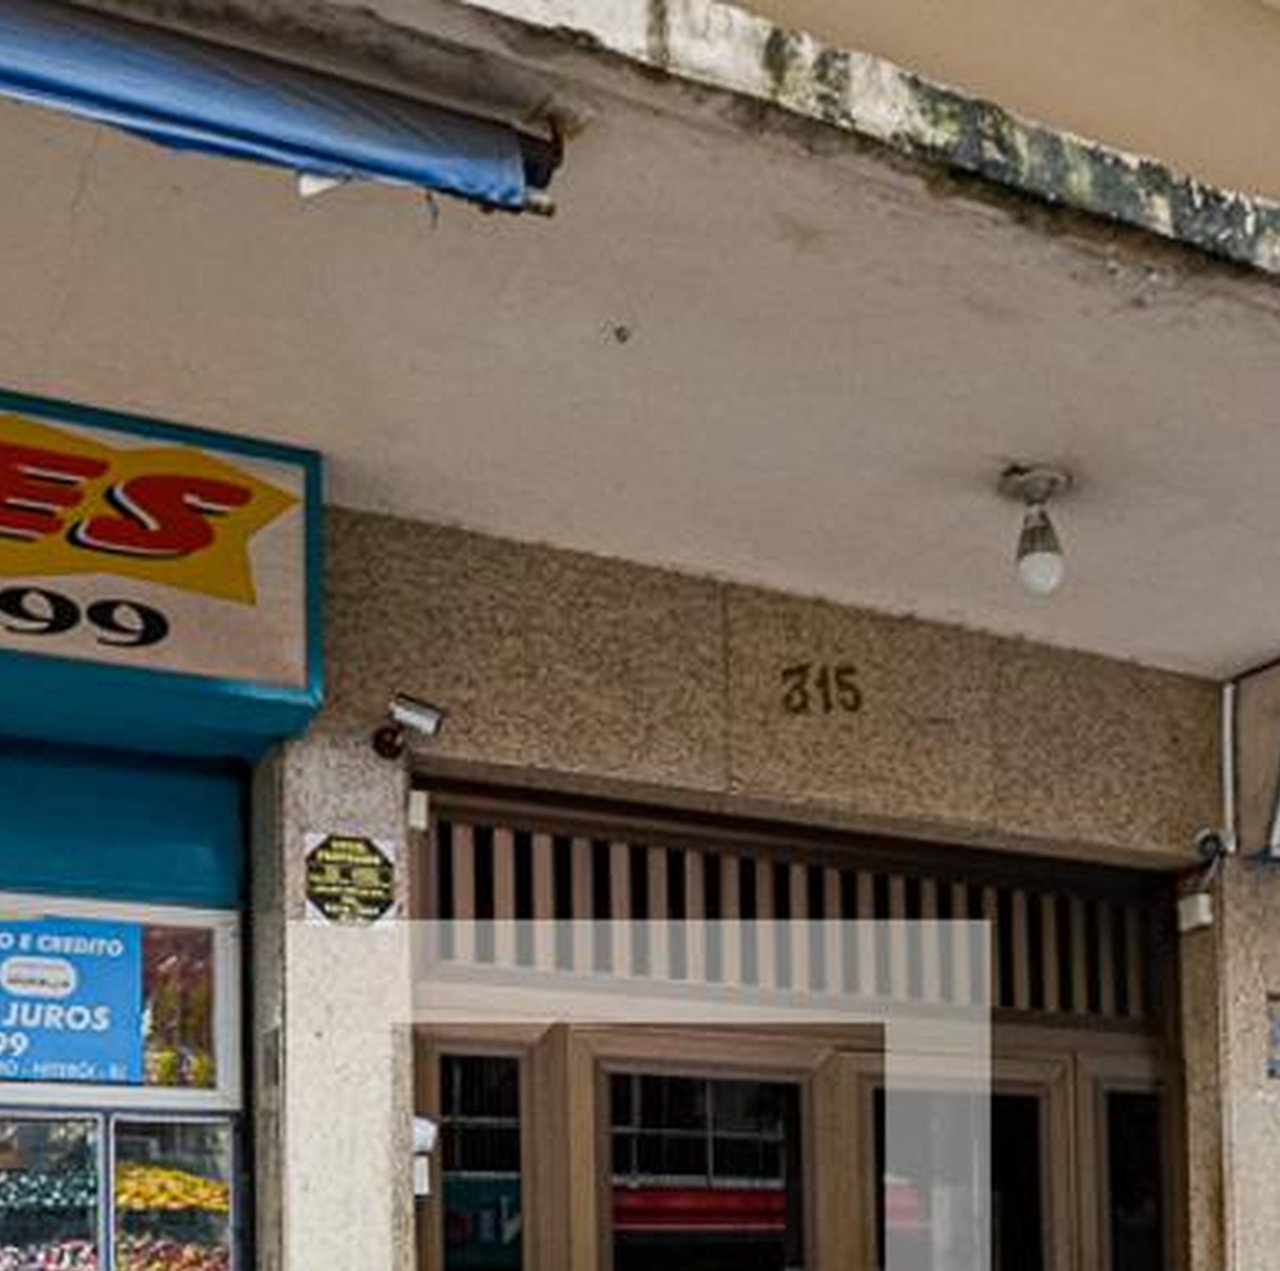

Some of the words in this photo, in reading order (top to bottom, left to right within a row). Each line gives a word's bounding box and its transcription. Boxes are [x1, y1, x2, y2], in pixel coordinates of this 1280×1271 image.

[781, 662, 862, 715] 315
[19, 932, 33, 951] E
[2, 1002, 111, 1032] JUROS
